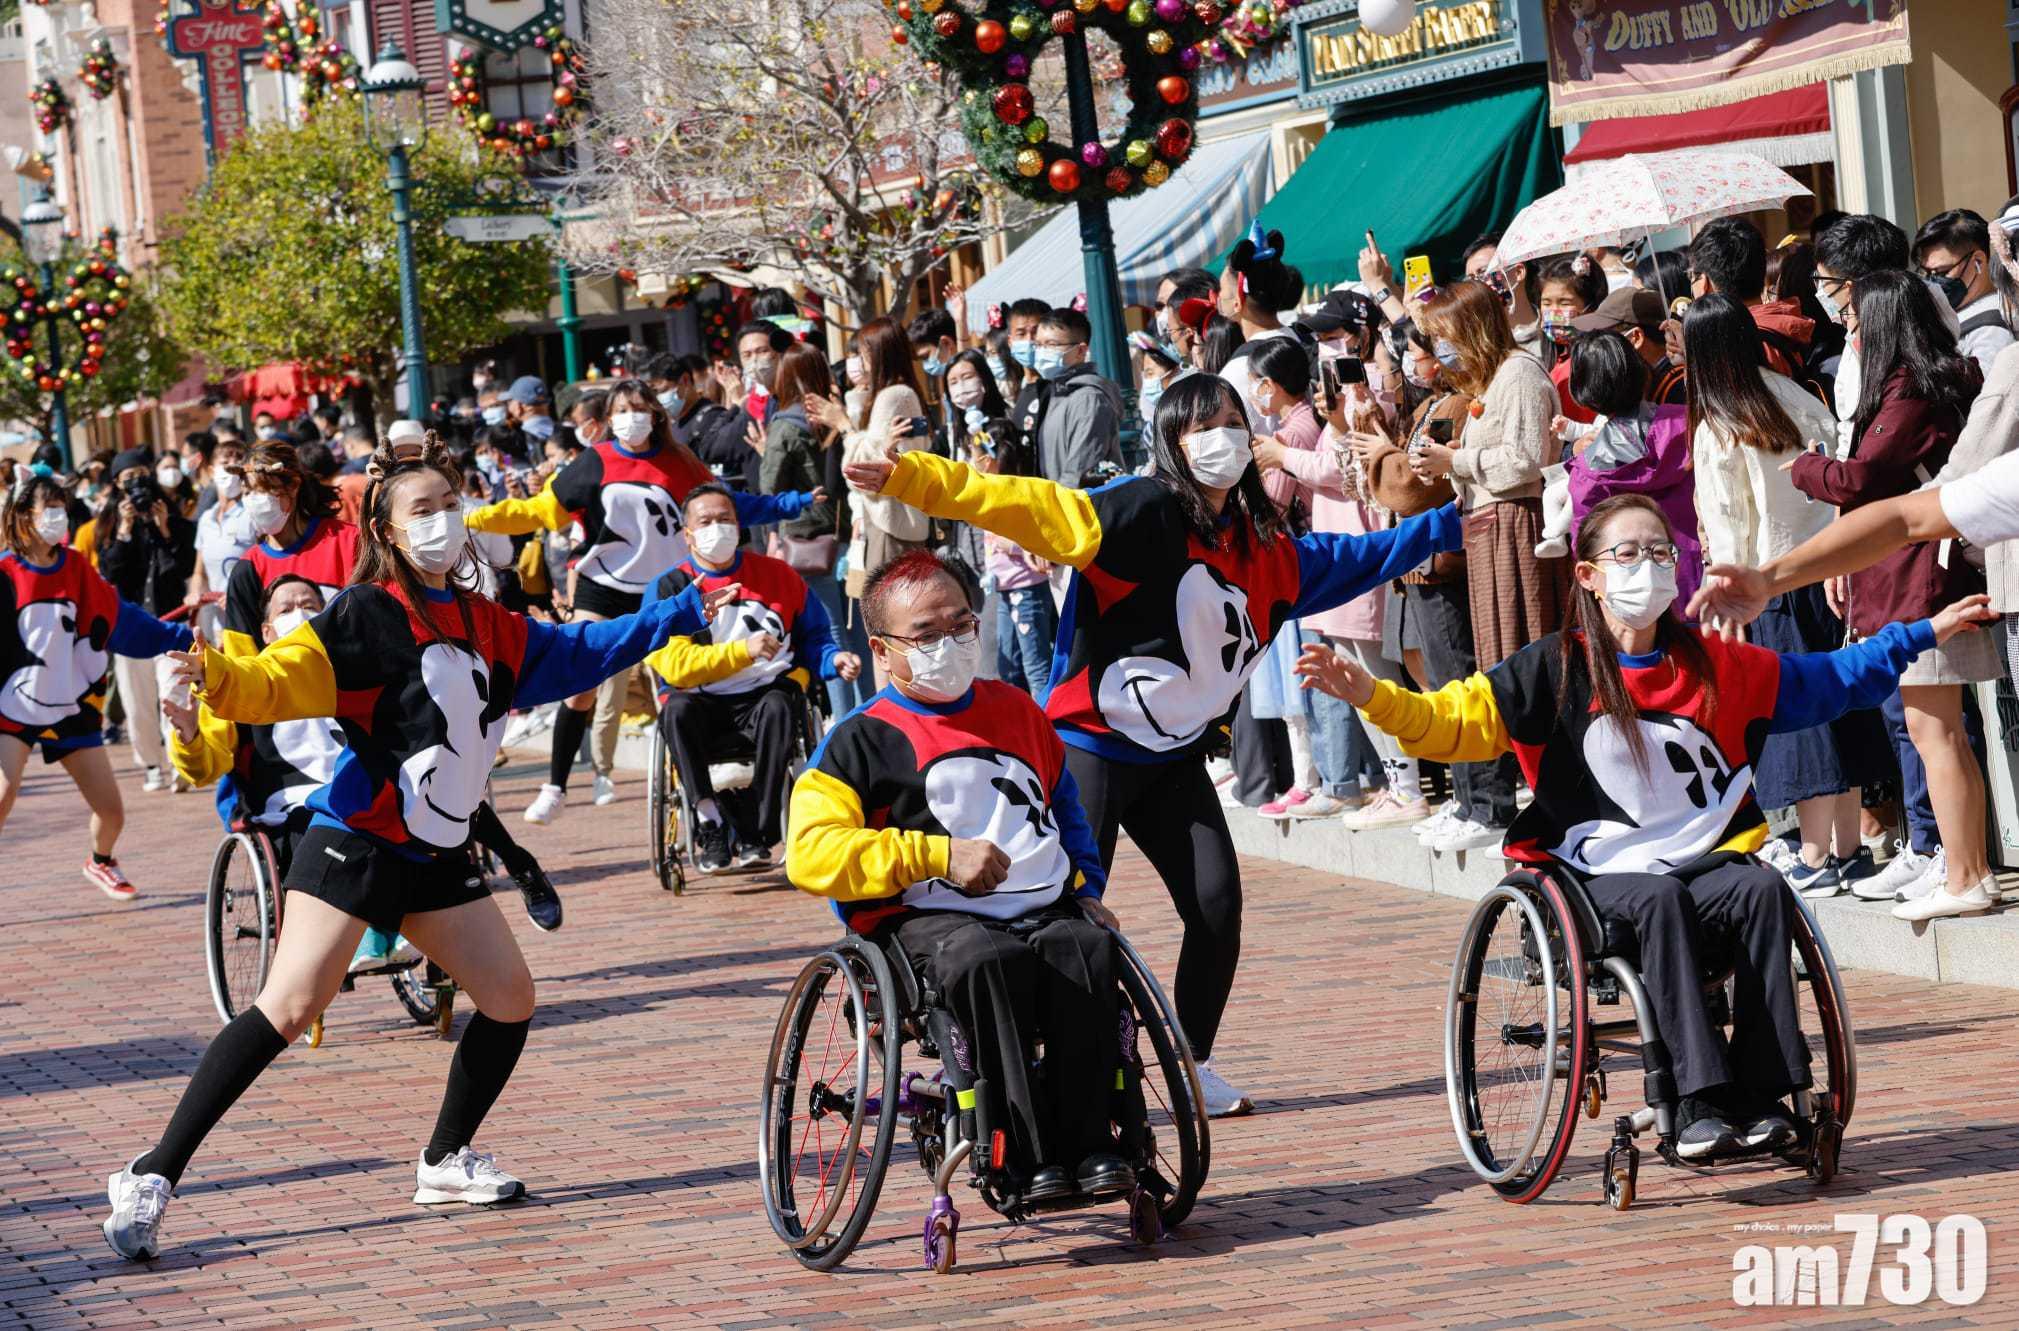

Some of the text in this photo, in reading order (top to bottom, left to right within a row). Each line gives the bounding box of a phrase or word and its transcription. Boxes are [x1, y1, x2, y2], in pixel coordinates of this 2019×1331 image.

[184, 20, 255, 48] Fine
[1604, 10, 1675, 51] DUFFY
[1680, 1, 1718, 41] AND
